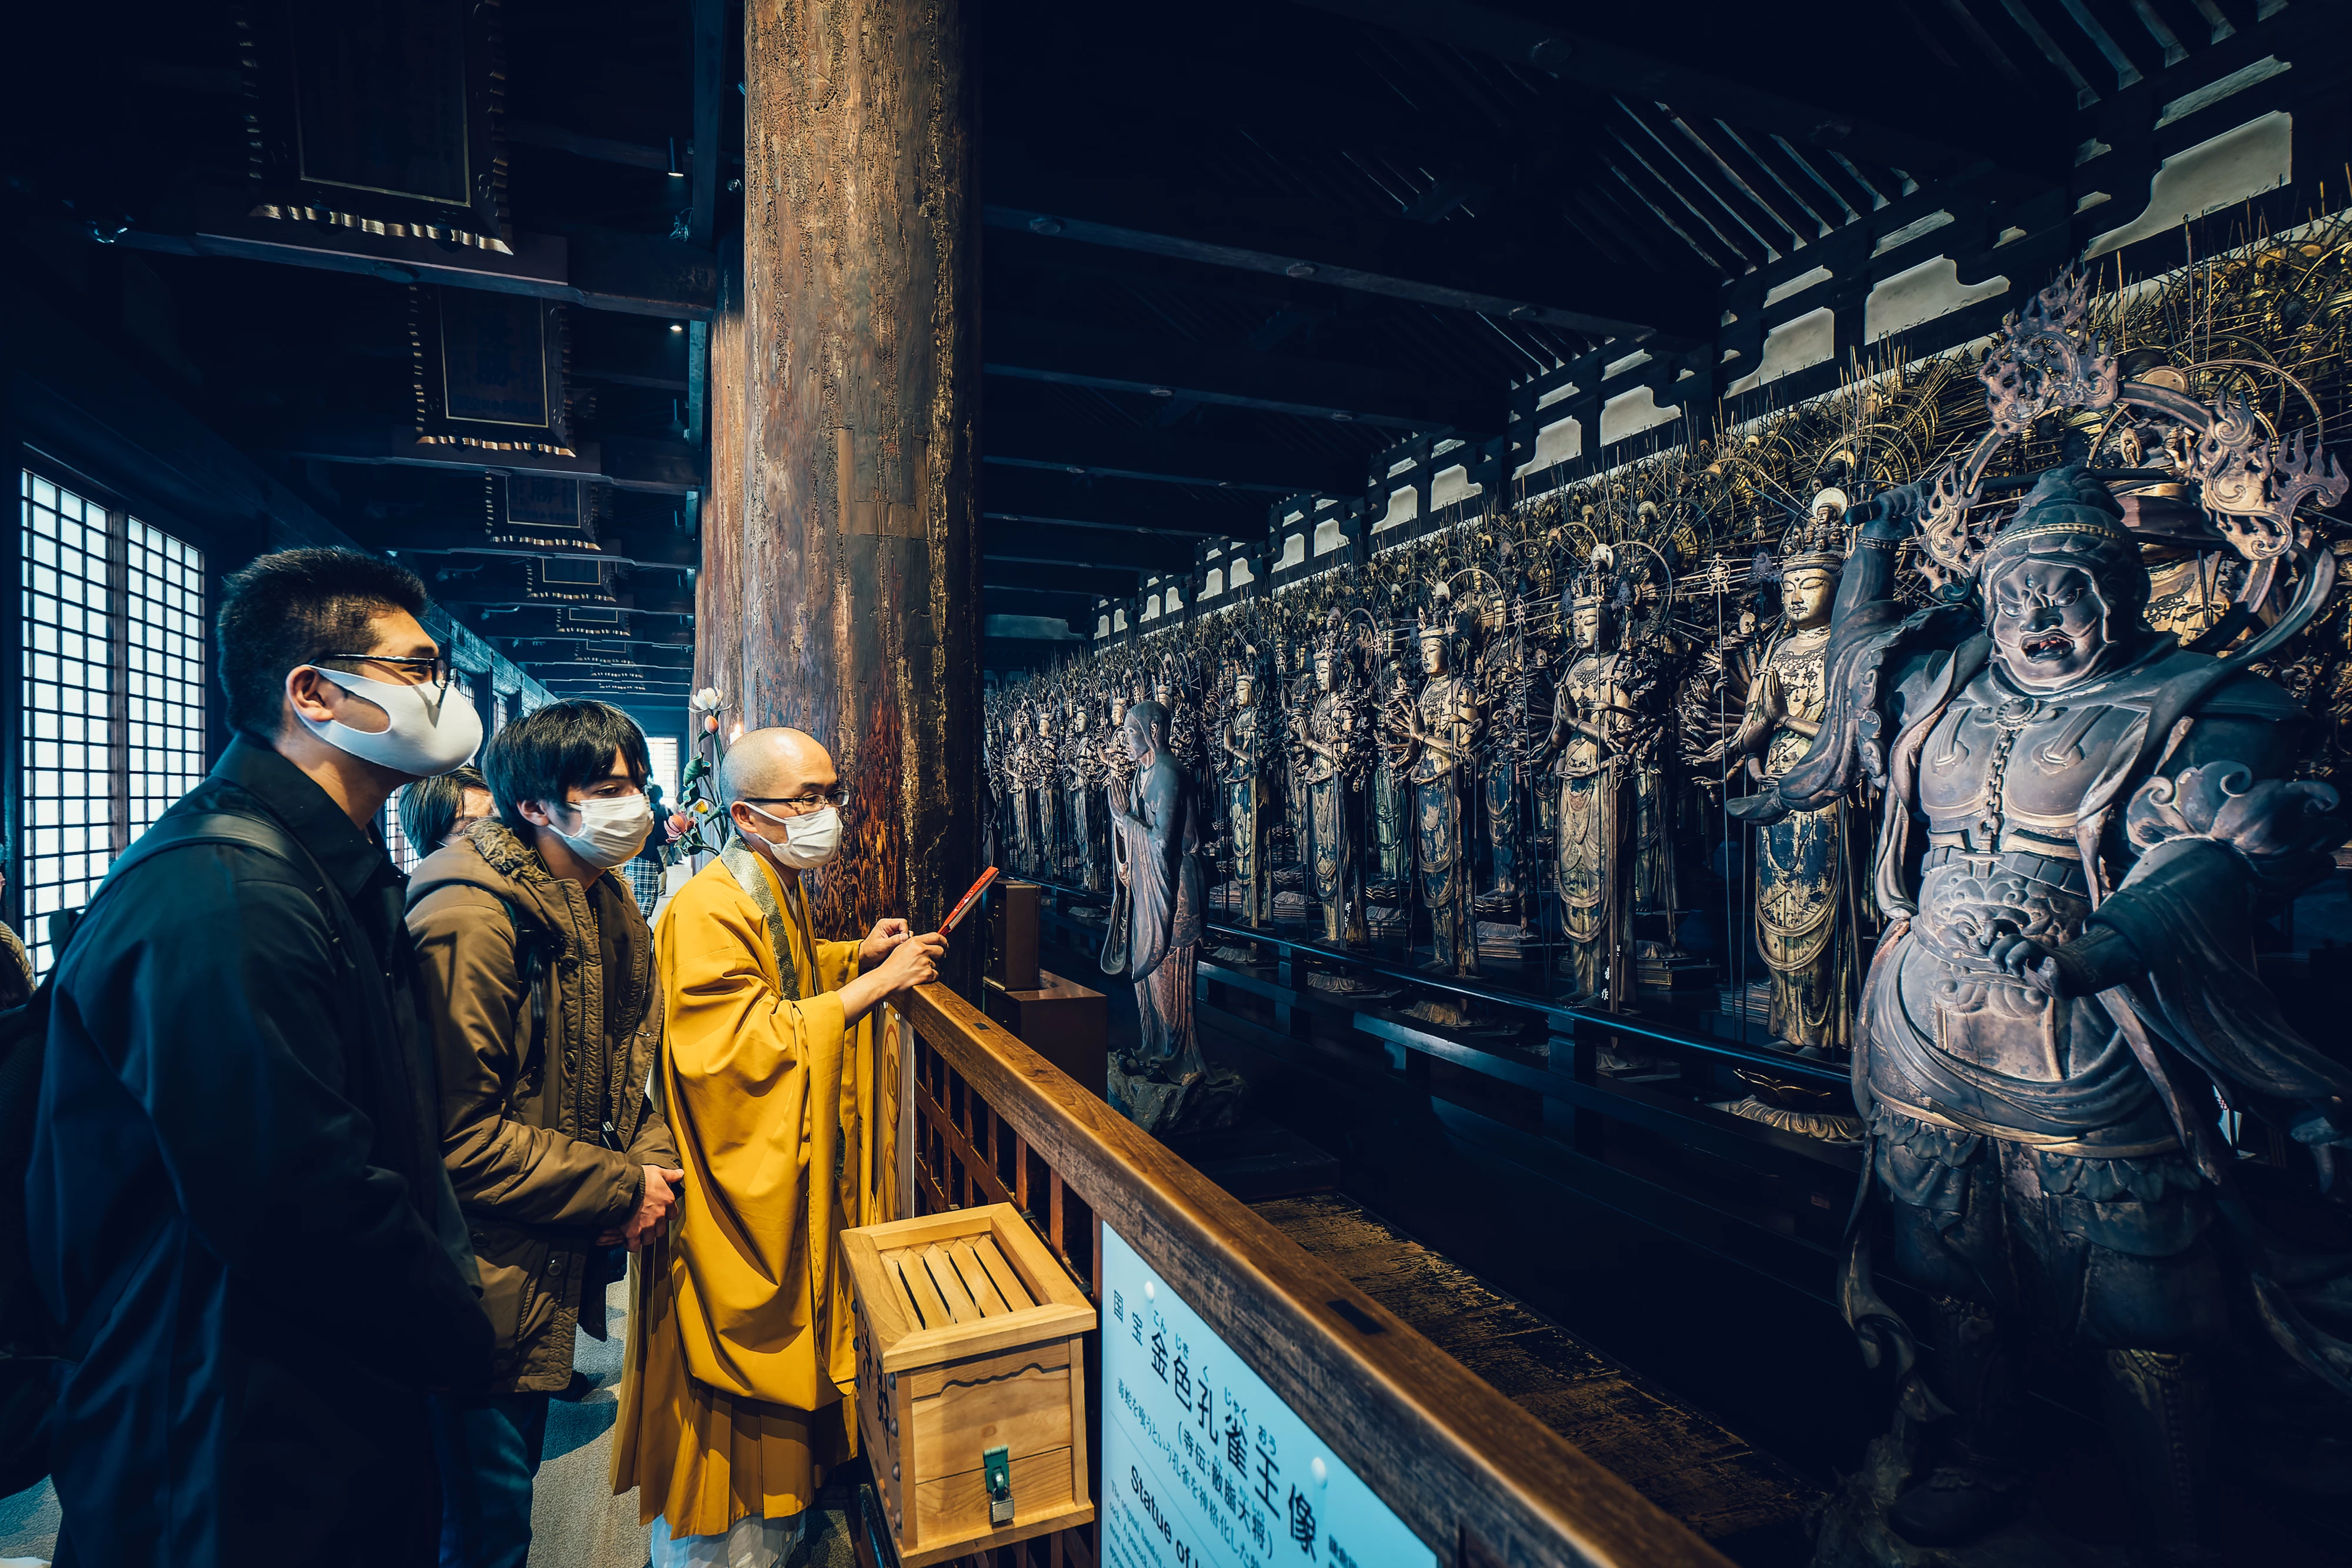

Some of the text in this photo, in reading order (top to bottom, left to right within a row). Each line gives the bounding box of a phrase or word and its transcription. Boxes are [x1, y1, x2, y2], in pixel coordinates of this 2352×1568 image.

[1150, 1330, 1318, 1564] 金色孔雀王像
[1153, 1309, 1277, 1456] こん じき く じゃく おう
[1130, 1465, 1191, 1568] Statue of
